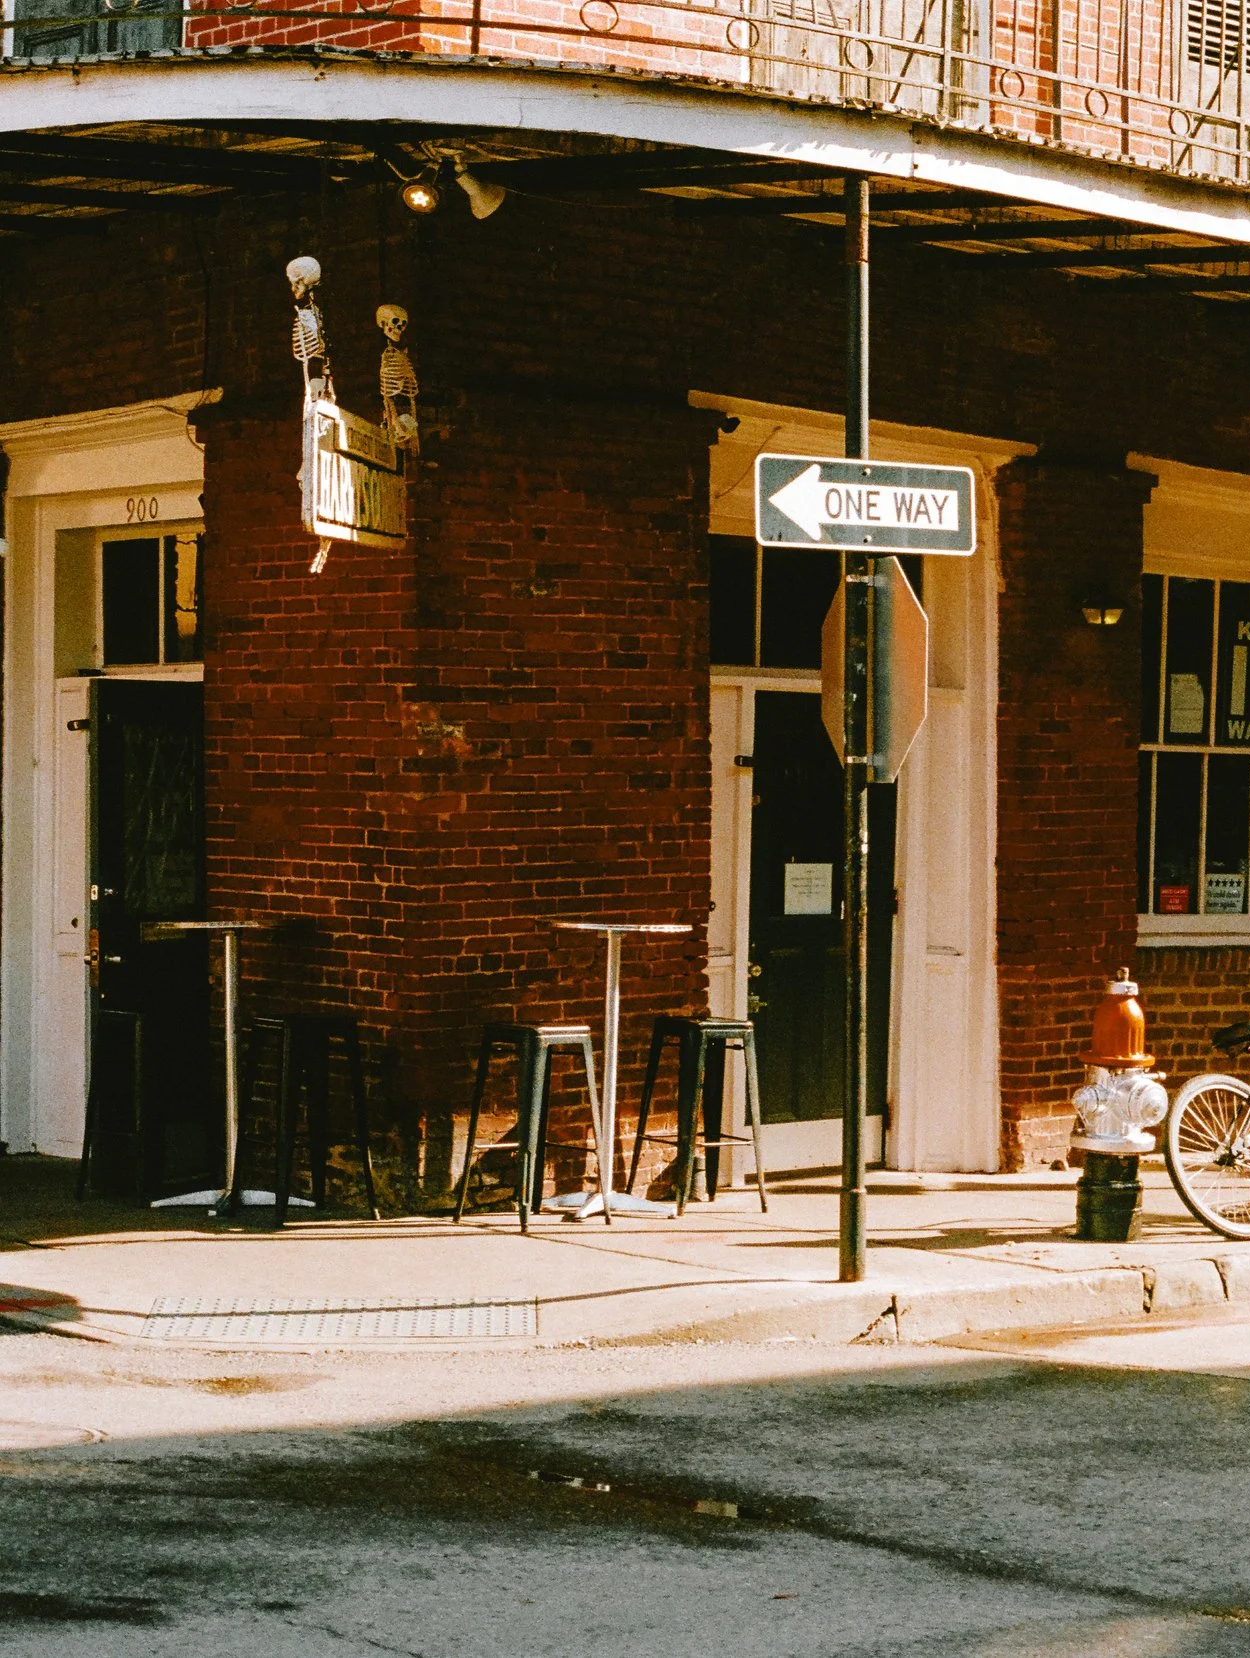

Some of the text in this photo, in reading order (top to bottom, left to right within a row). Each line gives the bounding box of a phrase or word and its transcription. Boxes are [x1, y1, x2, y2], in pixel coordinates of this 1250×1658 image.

[126, 497, 158, 522] 900
[825, 487, 949, 525] ONE WAY
